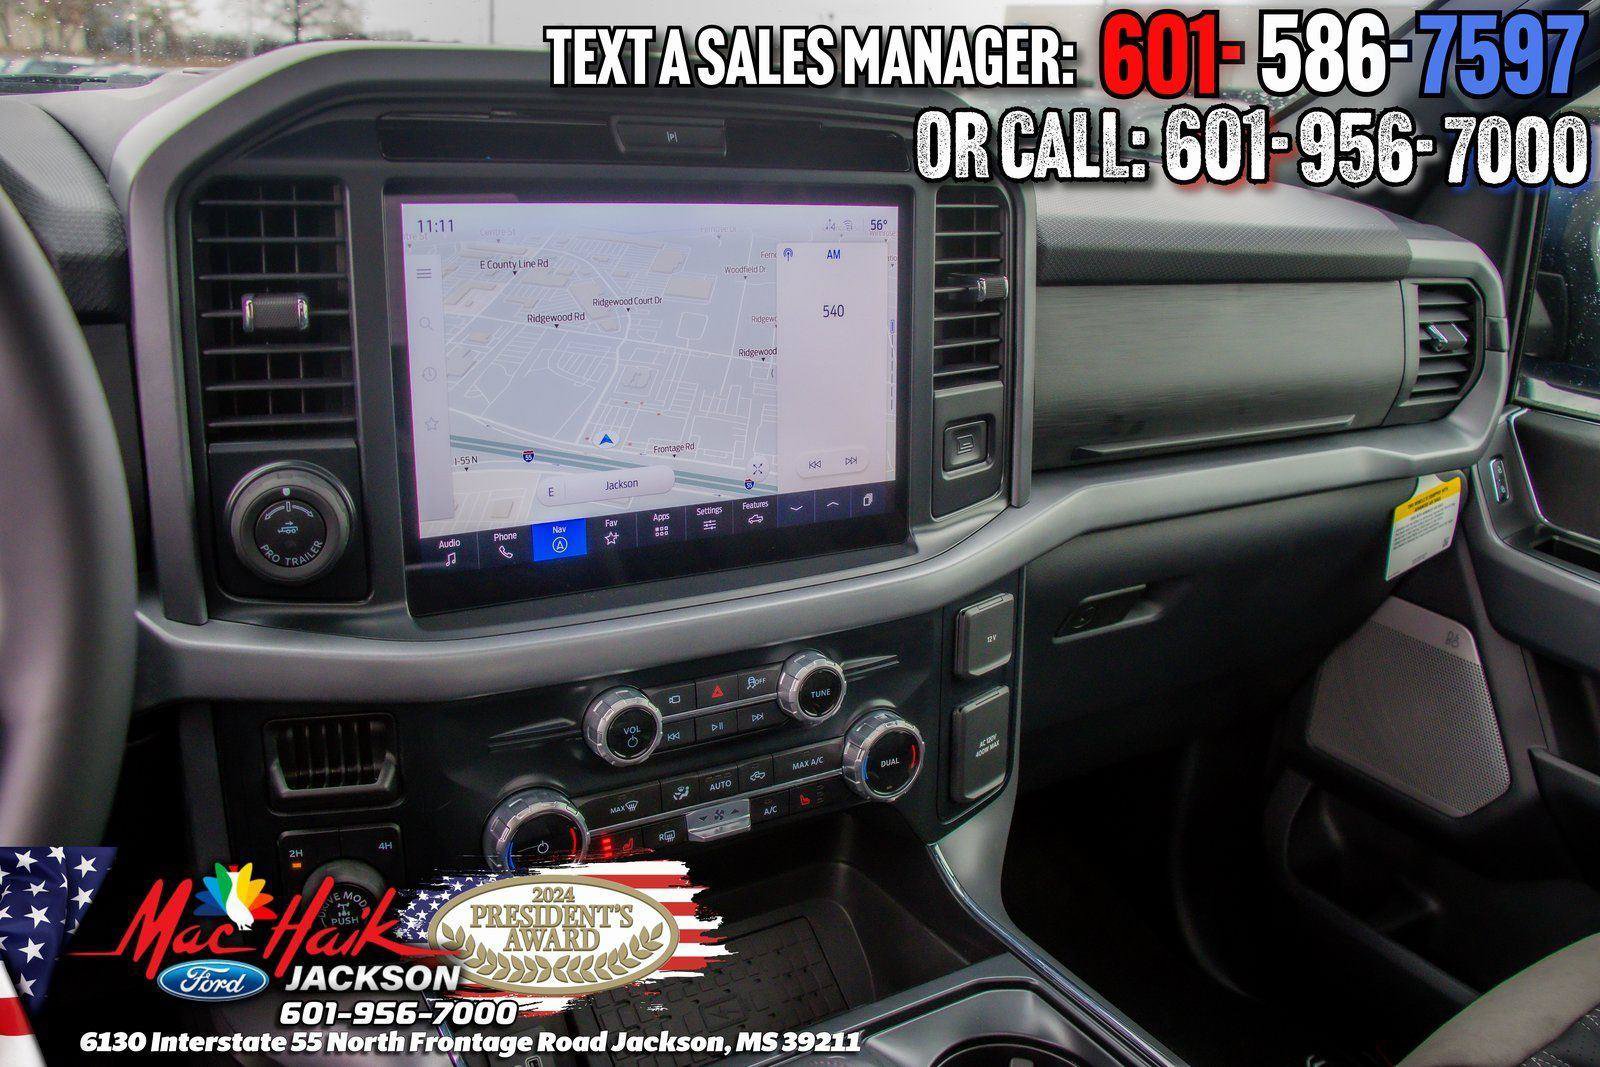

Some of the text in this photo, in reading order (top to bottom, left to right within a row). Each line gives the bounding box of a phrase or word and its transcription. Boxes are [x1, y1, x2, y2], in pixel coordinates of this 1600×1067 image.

[418, 219, 455, 233] 11:11
[871, 219, 888, 231] 56°
[826, 249, 841, 260] AM
[480, 258, 549, 271] E County Line Rd
[725, 265, 767, 275] Woodfield Dr
[592, 296, 663, 308] Ridgewood Court Dr
[822, 304, 845, 318] 540
[527, 312, 586, 324] Ridgewood Rd
[738, 347, 777, 358] Ridgewood
[653, 442, 695, 454] Frontage Rd
[454, 455, 478, 466] I-55 N
[548, 478, 639, 497] E Jackson
[696, 505, 723, 516] Settings
[742, 500, 769, 510] Features
[653, 512, 670, 522] Apps
[605, 518, 618, 528] Fav
[552, 525, 567, 533] Nav
[493, 532, 518, 542] Phone
[438, 539, 461, 549] Audio
[260, 539, 324, 566] PRO TRAILER
[987, 634, 997, 643] 12V
[811, 688, 831, 699] TUNE
[623, 725, 641, 735] VOL
[792, 756, 824, 771] MAX A/C
[880, 756, 900, 768] DUAL
[709, 778, 732, 792] AUTO
[610, 805, 626, 815] MAX
[764, 805, 778, 816] A/C
[378, 842, 393, 850] 4H
[289, 849, 304, 858] 2H
[331, 916, 359, 926] PUSH
